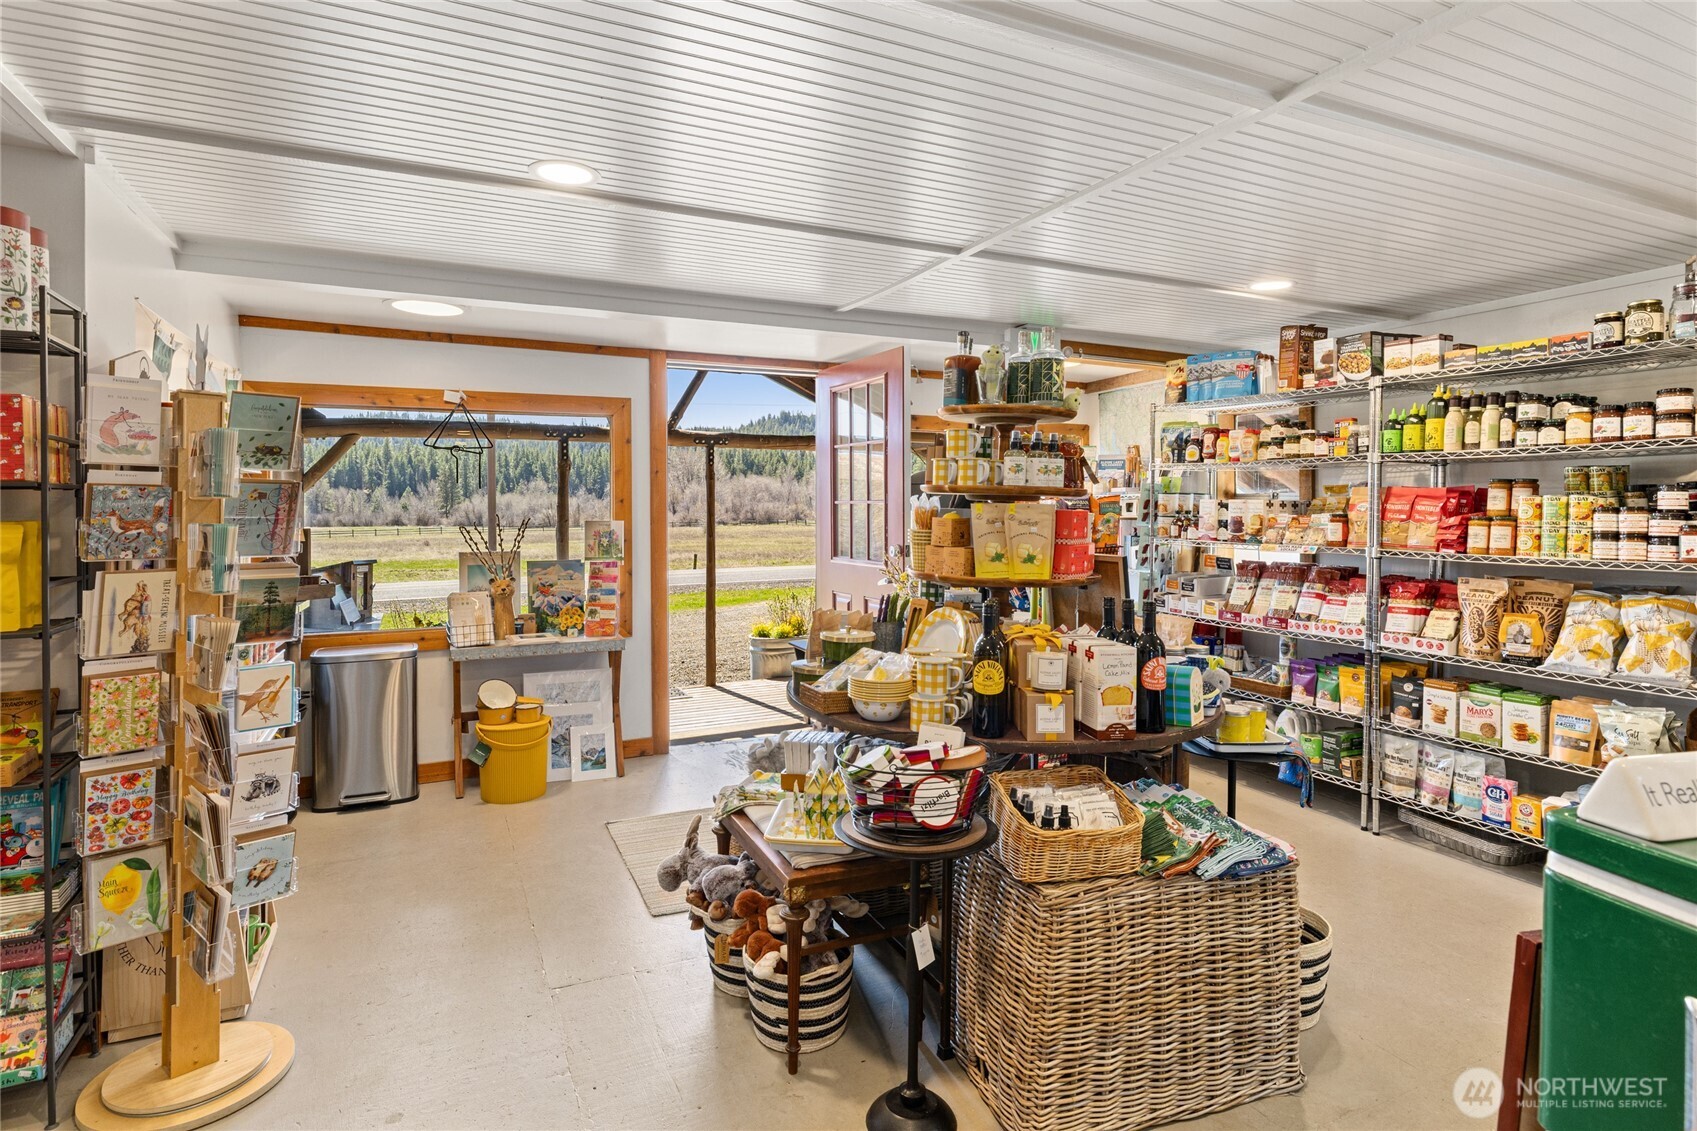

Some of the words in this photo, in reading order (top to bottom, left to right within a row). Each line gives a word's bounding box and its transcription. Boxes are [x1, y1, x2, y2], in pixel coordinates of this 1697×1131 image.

[1516, 595, 1564, 604] PEANUTS
[1, 700, 37, 708] TRANSPORT
[120, 684, 133, 743] Congratulations
[1466, 706, 1494, 717] MARY'S
[1626, 728, 1640, 741] Salt
[96, 793, 118, 802] Happy
[97, 879, 117, 889] Main
[97, 885, 129, 899] Squeeze
